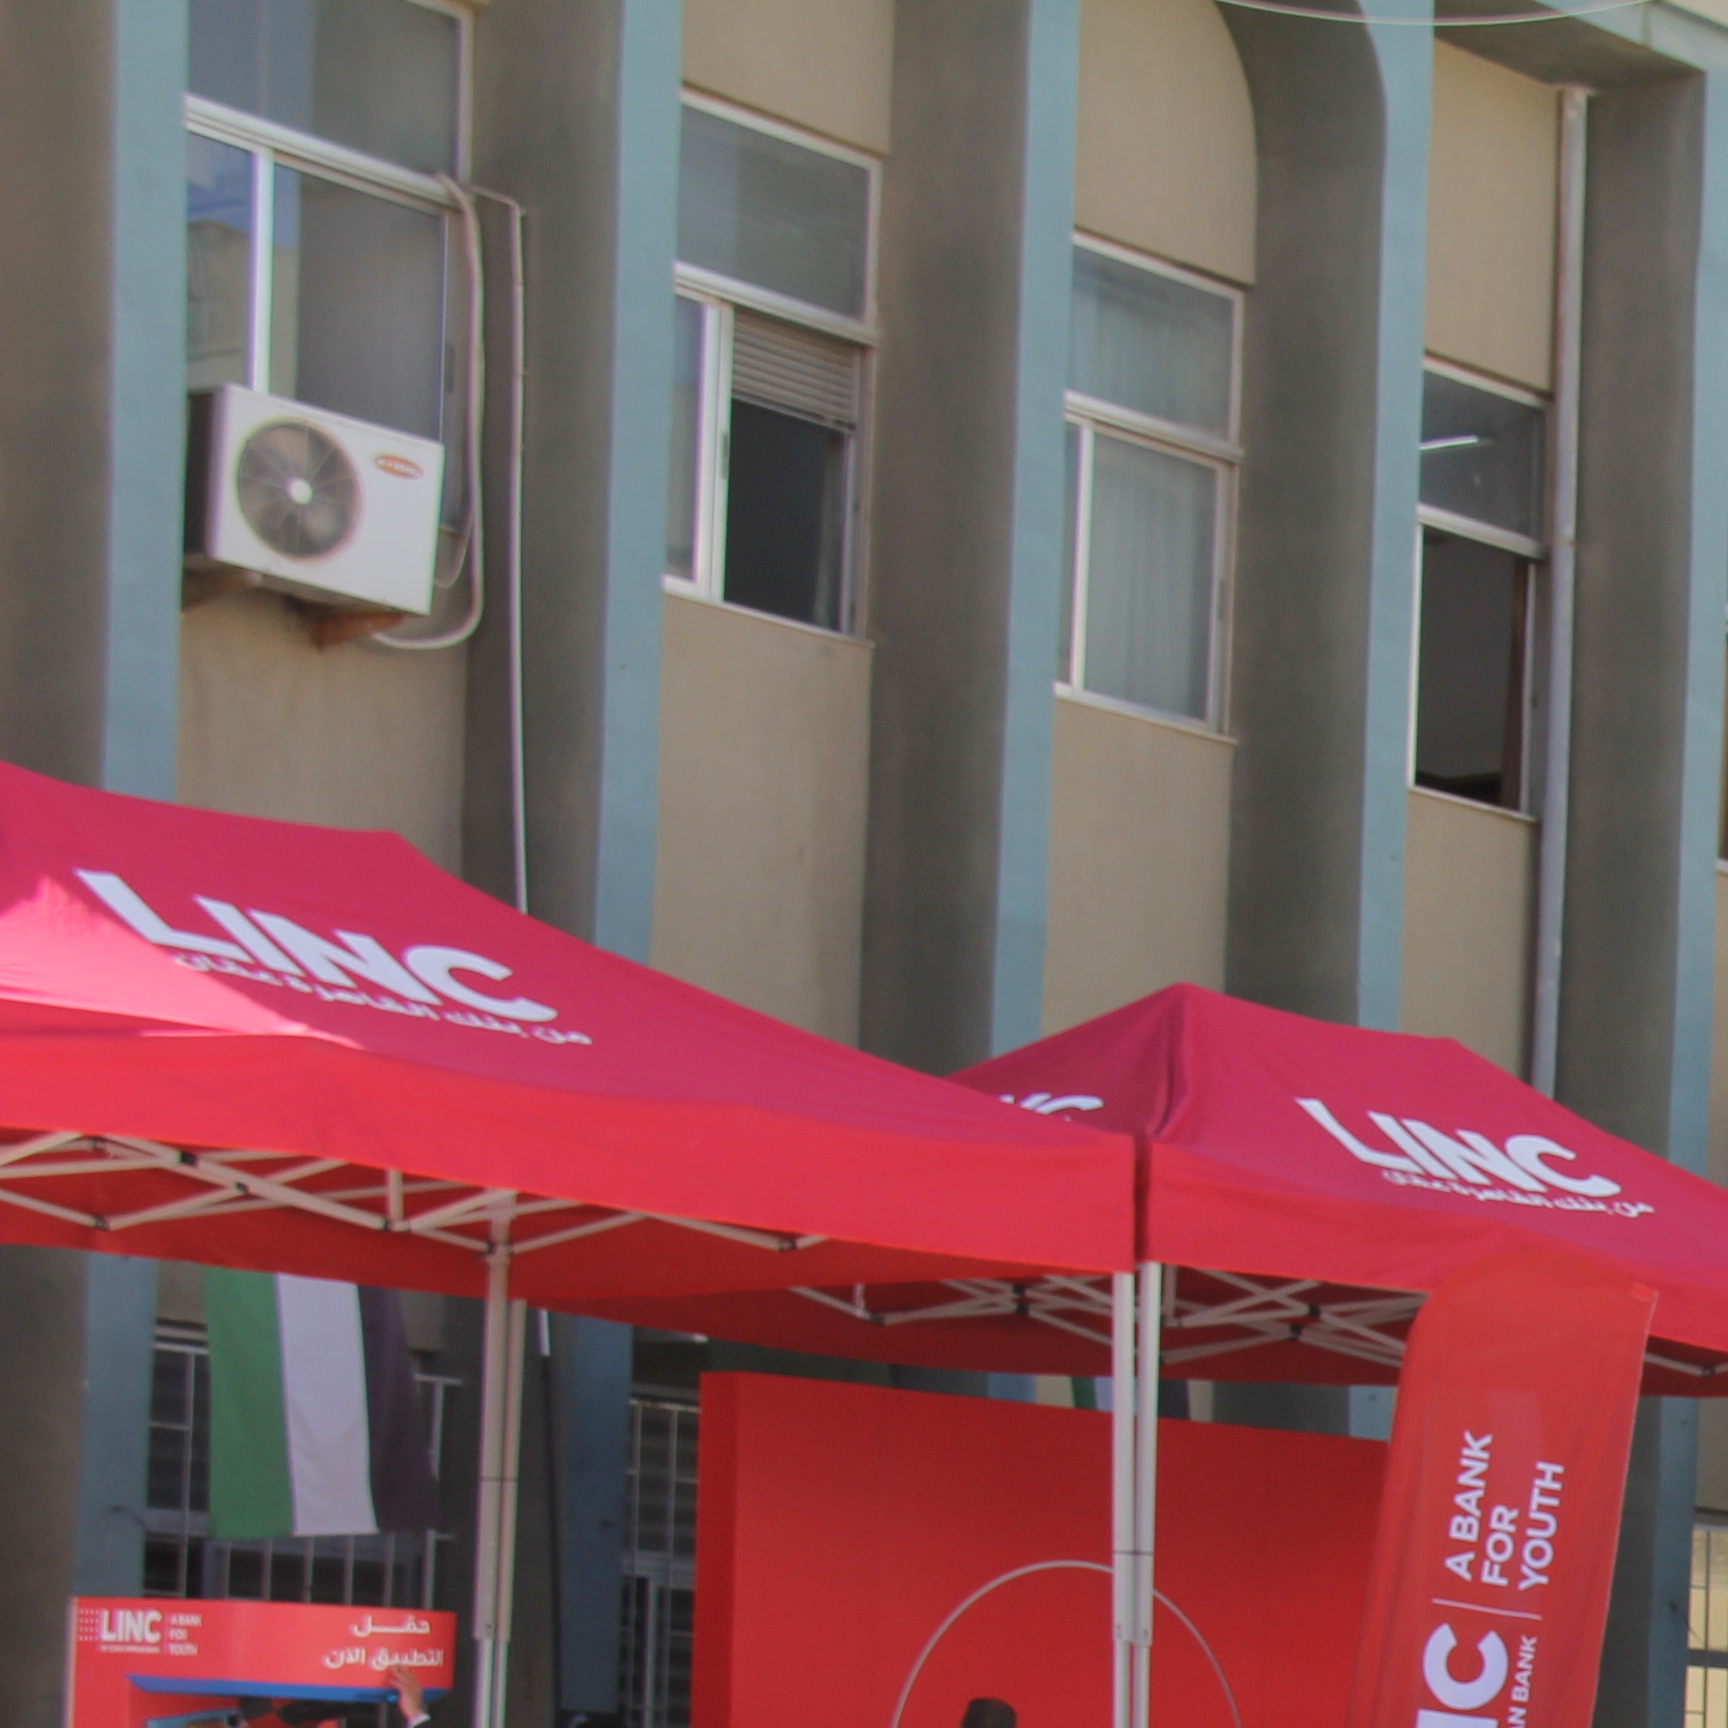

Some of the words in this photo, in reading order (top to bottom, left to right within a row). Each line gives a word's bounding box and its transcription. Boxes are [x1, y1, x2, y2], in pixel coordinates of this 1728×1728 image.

[74, 868, 558, 1022] LINC
[1294, 1098, 1621, 1197] LINC
[1452, 1430, 1493, 1546] BANK
[1517, 1461, 1565, 1591] YOUTH
[1444, 1550, 1476, 1583] A
[1480, 1505, 1519, 1588] FOR
[101, 1609, 162, 1643] LINC
[169, 1644, 198, 1656] YOUTH
[1512, 1636, 1538, 1706] BANK
